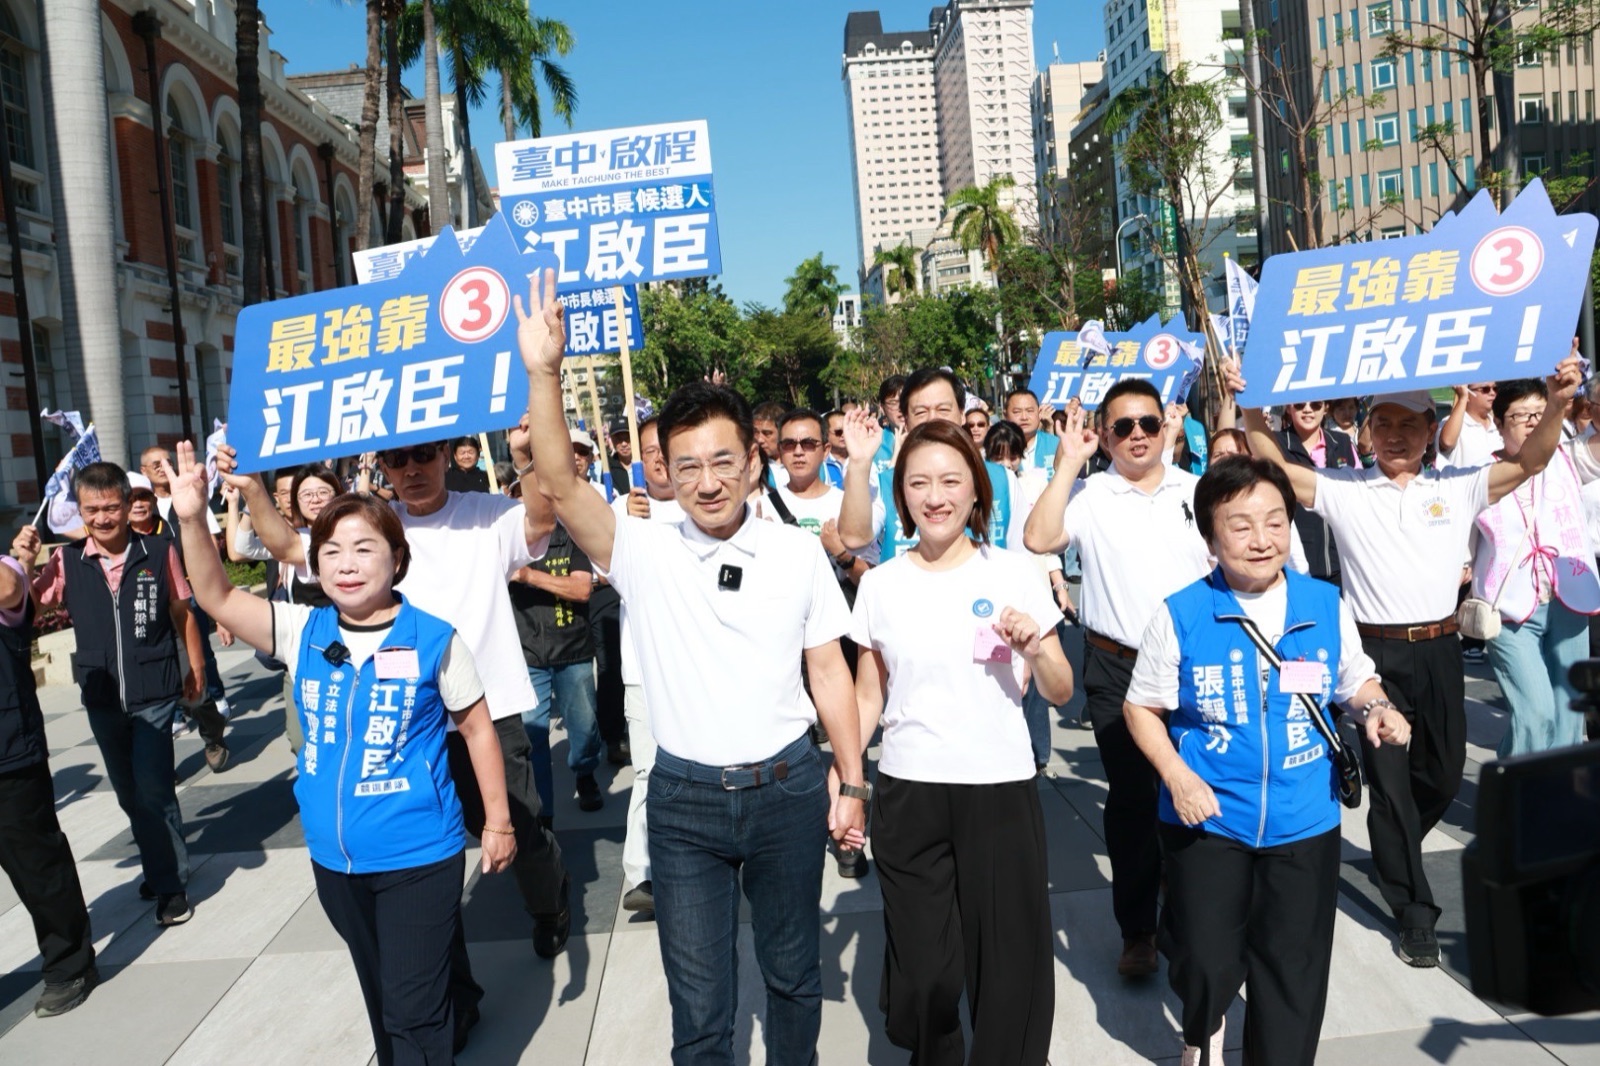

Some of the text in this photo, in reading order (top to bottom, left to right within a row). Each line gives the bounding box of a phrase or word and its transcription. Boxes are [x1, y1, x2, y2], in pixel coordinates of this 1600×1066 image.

[541, 166, 671, 189] MAKE TAICHUNG THE BEST
[543, 182, 710, 223] 臺中市長候選人
[523, 212, 711, 284] 江啟臣
[1287, 236, 1524, 317] 最強靠 3
[265, 279, 492, 374] 最強靠 3
[565, 307, 635, 353] 啟臣
[1041, 371, 1174, 406] 江啟！
[323, 684, 341, 745] 立法委員
[360, 683, 400, 779] 江啟臣
